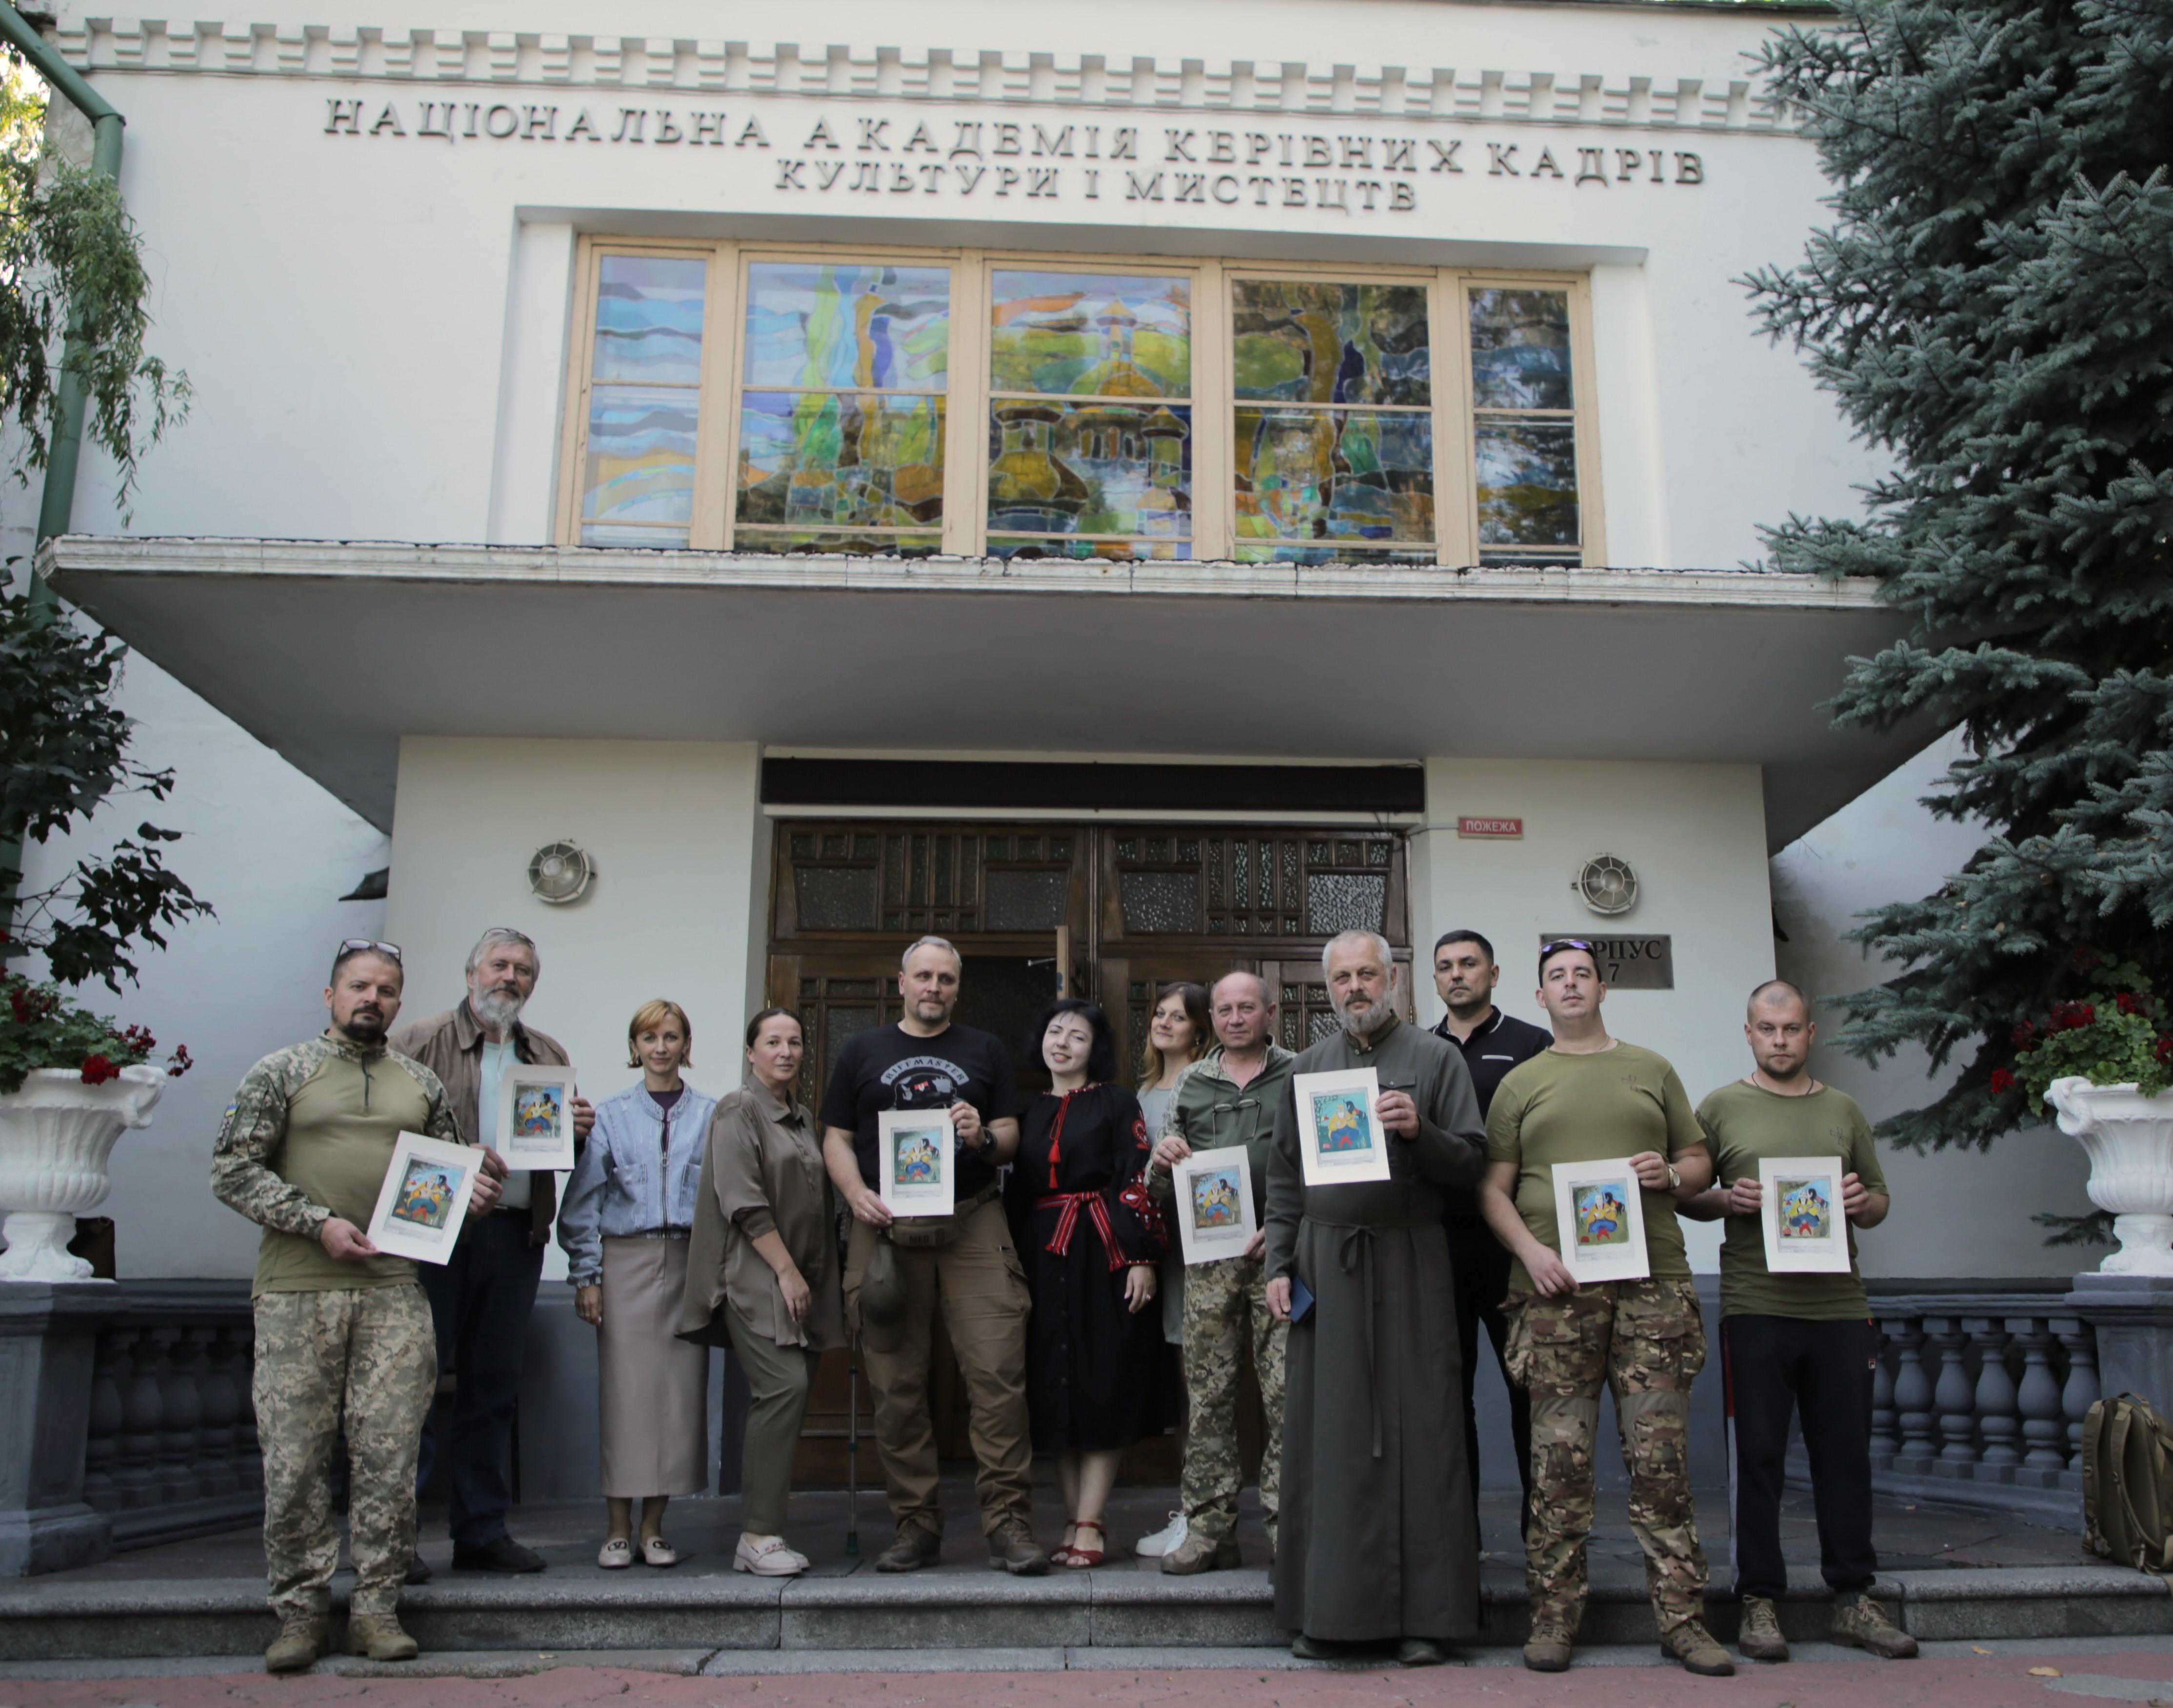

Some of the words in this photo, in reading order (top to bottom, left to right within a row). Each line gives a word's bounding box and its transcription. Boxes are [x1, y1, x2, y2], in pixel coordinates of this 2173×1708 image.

[324, 99, 770, 147] НАЦІОНАЛЬНА
[803, 114, 1138, 161] АКАДЕМІЯ
[1164, 128, 1463, 173] КЕРІВНИХ
[1487, 141, 1705, 188] КАДРІВ
[775, 159, 1058, 198] КУЛЬТУРИ
[1085, 169, 1100, 199] І
[1125, 171, 1417, 215] МИСТЕЦТВ
[1466, 820, 1516, 833] ПОЖЕЖА
[1550, 939, 1662, 959] РПУС
[1608, 963, 1620, 982] 7
